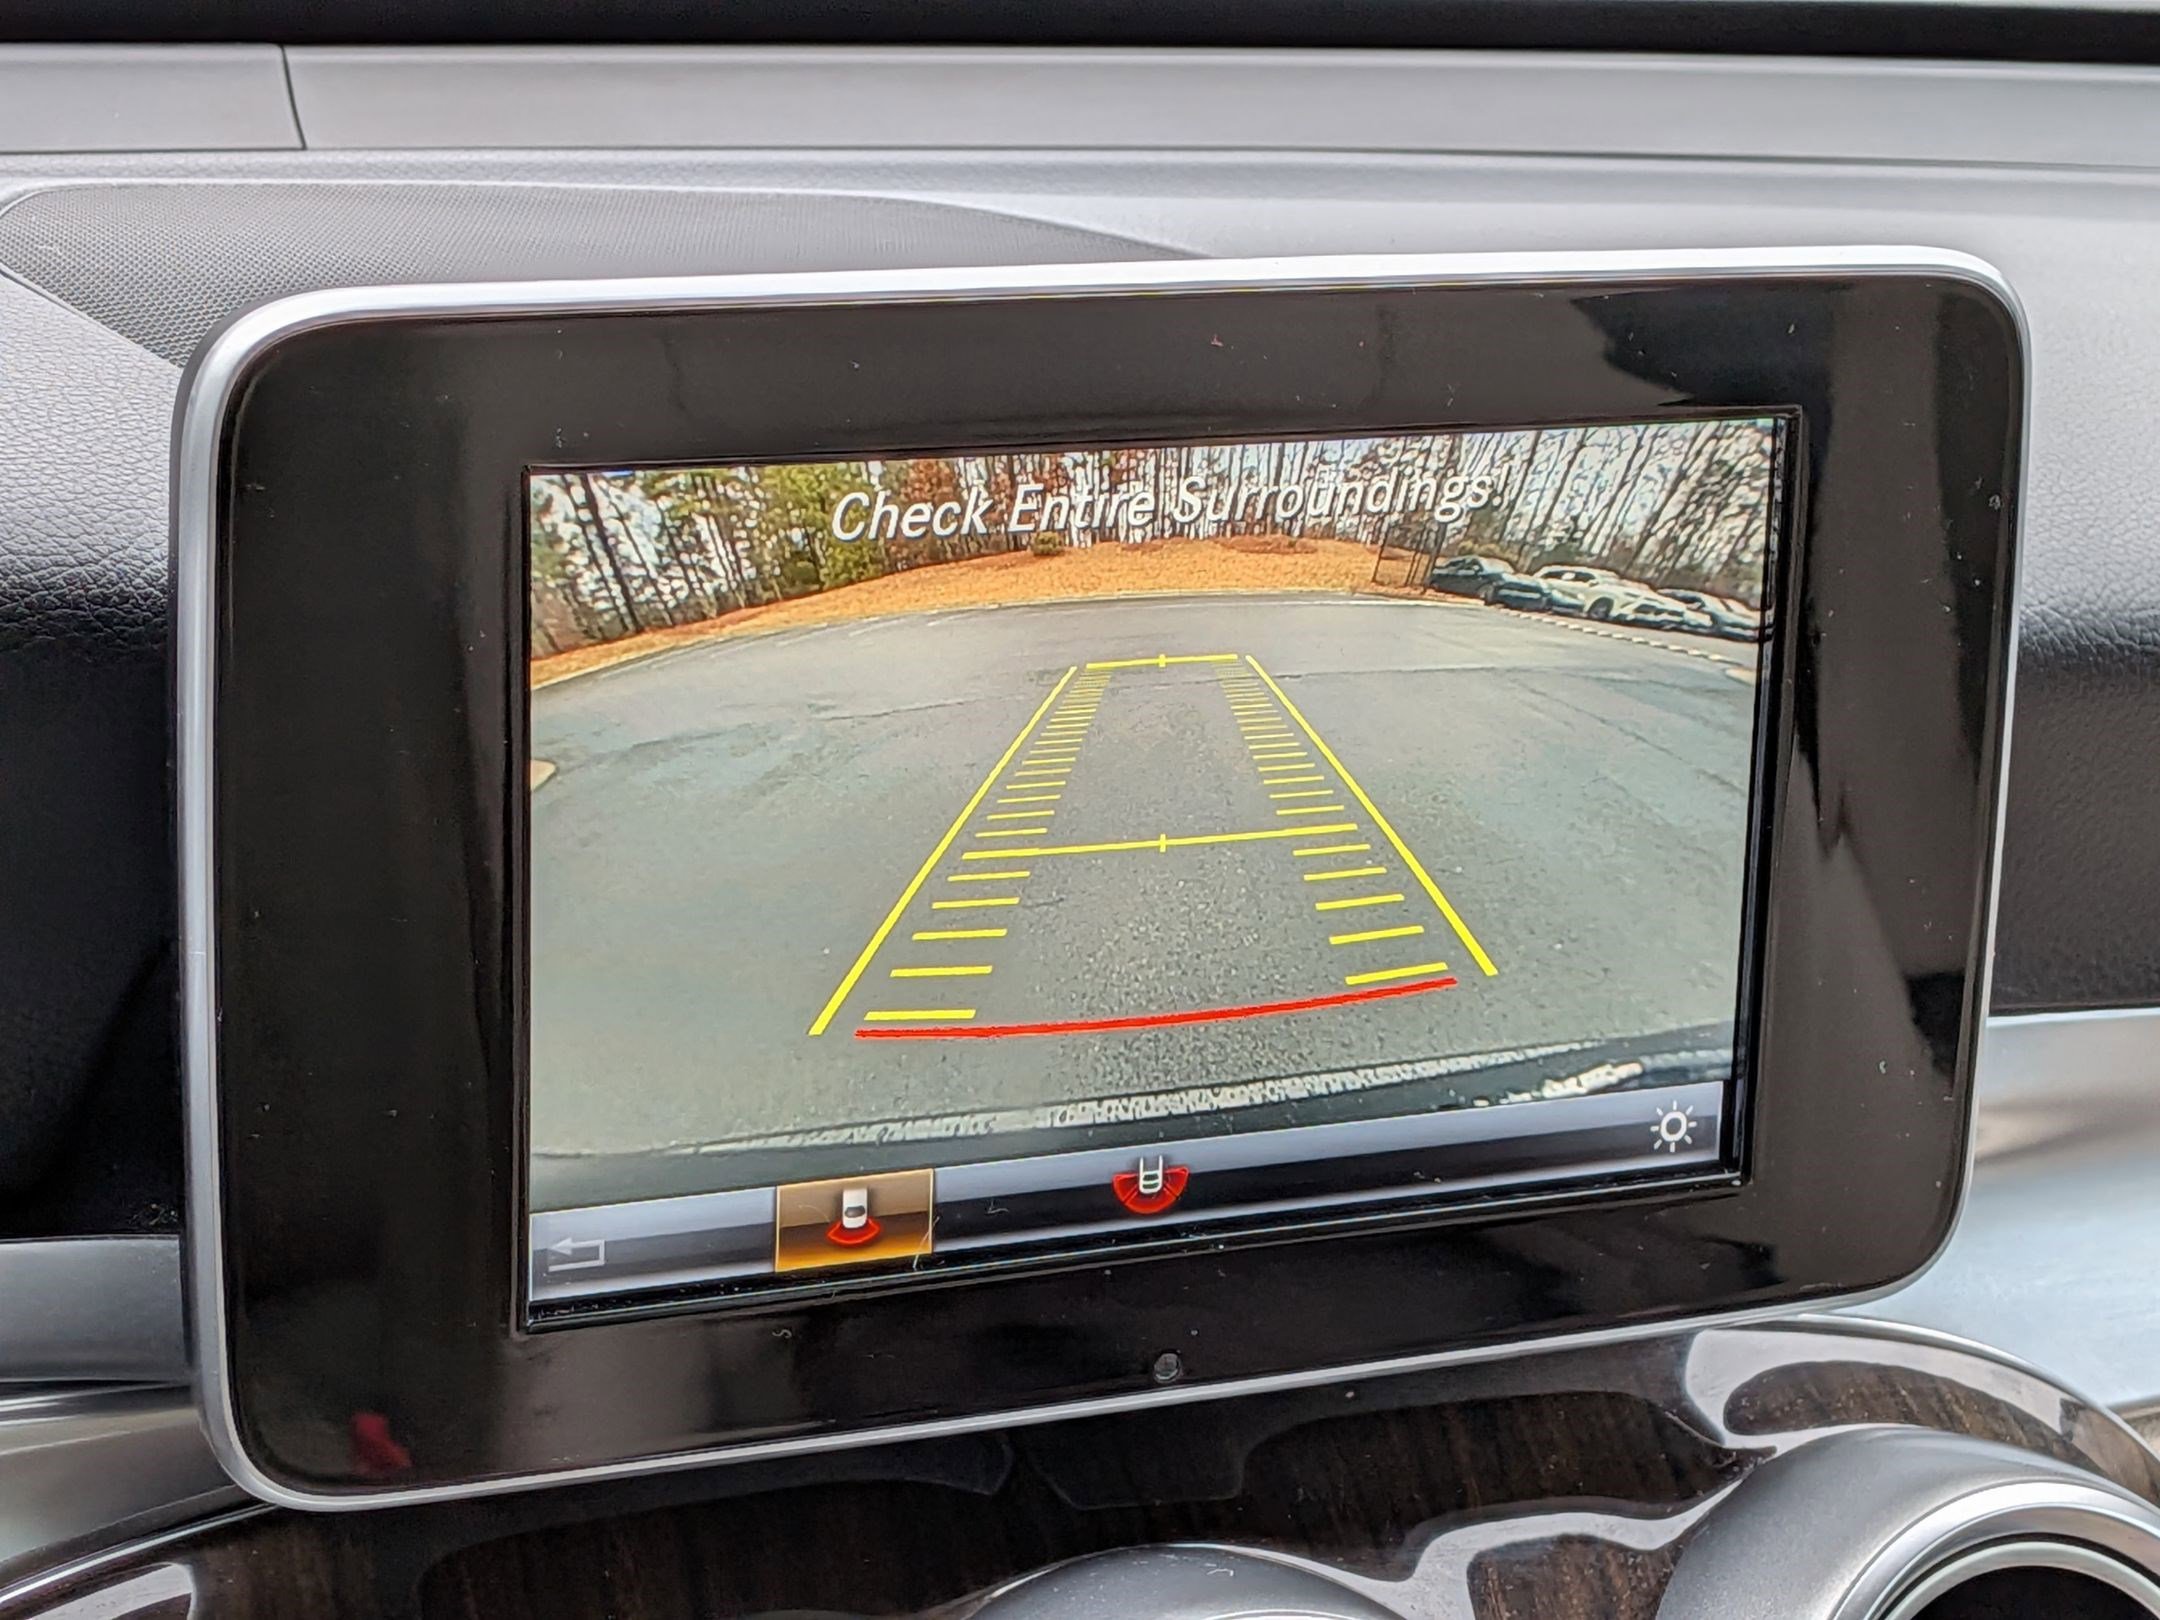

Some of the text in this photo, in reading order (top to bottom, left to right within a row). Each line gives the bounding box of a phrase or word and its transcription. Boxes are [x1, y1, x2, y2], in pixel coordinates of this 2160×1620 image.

[831, 462, 1510, 541] Check Entire Surroundings!
